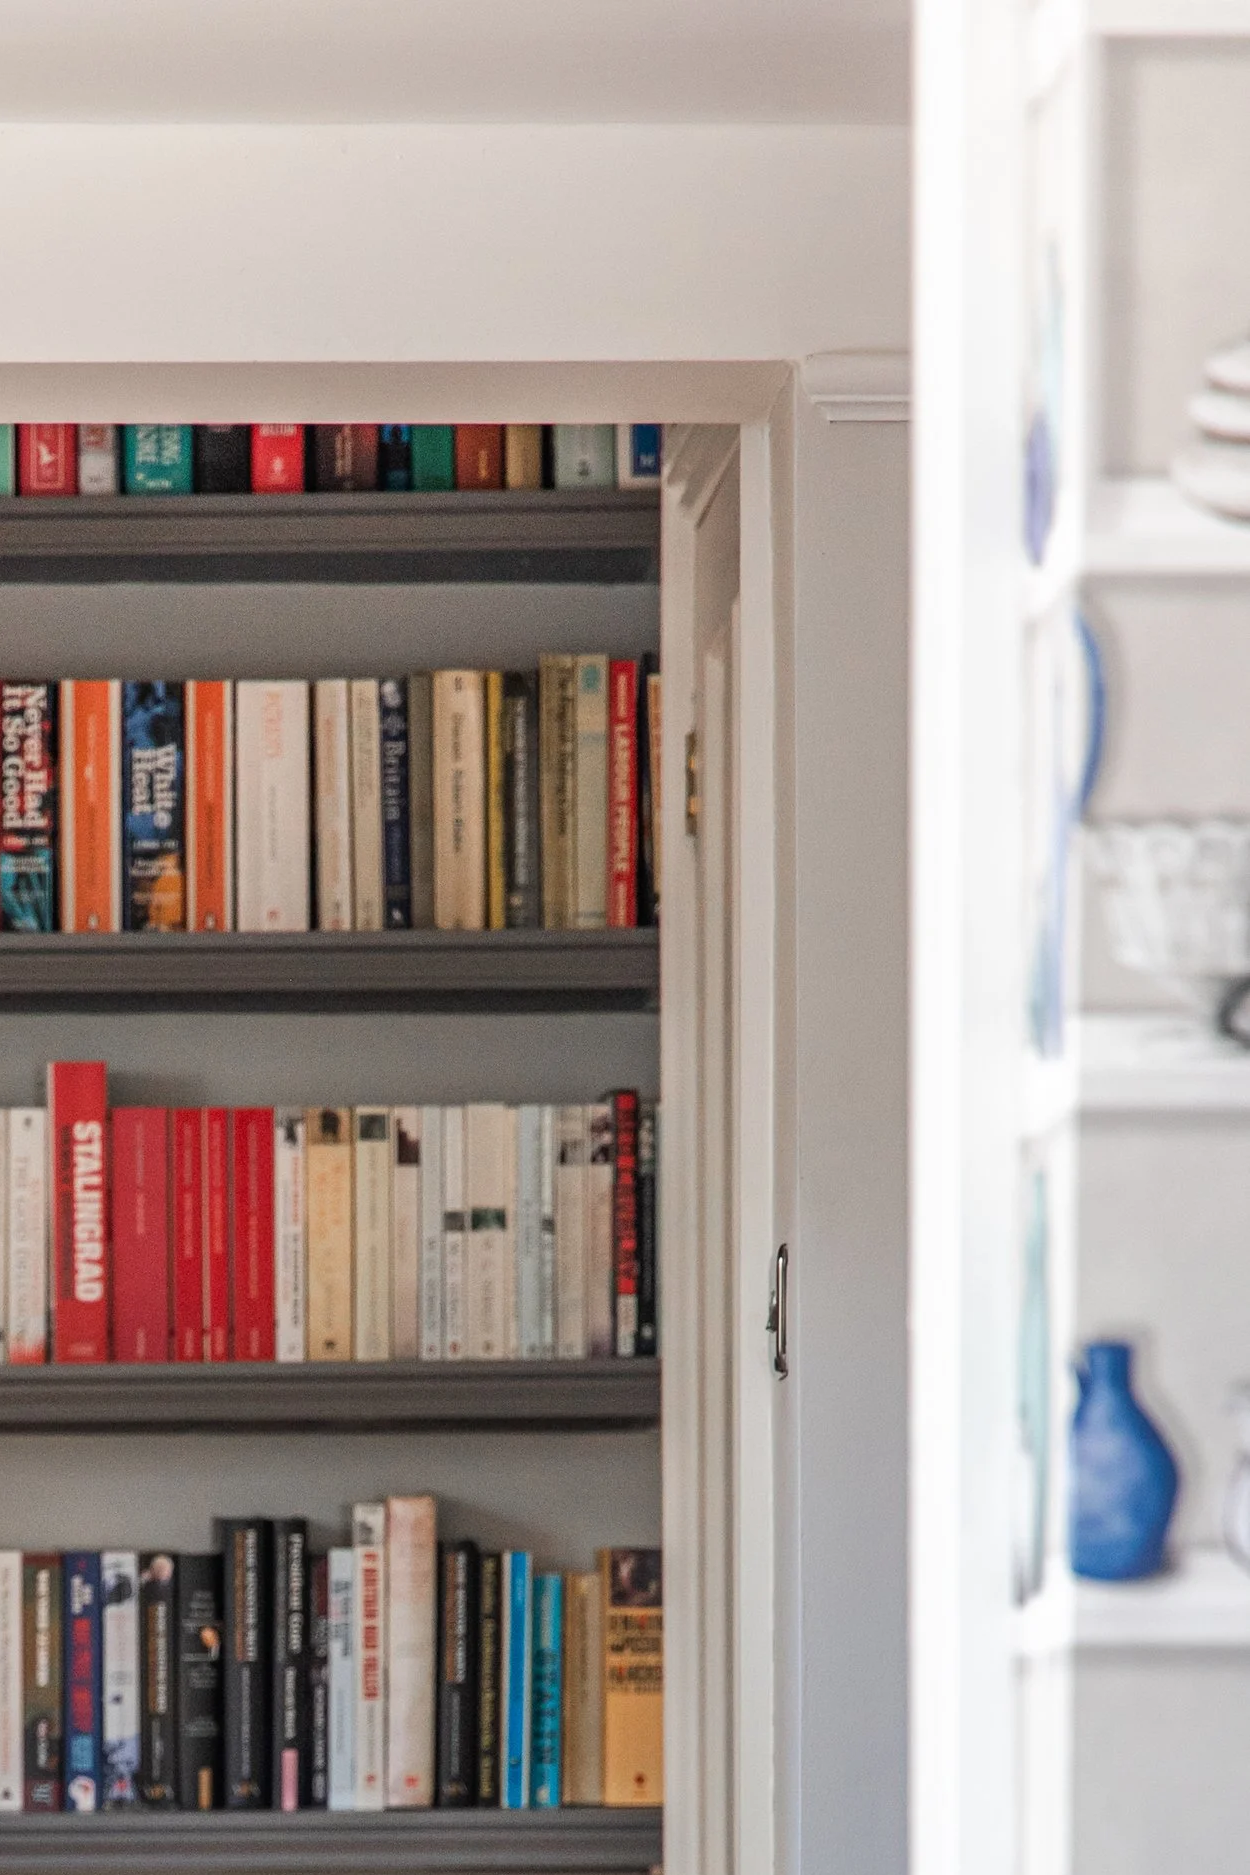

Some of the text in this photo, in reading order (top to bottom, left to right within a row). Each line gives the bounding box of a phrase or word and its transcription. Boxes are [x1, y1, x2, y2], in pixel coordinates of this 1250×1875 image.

[2, 686, 22, 828] It So Good
[24, 686, 46, 828] Never Had
[131, 748, 152, 815] Heat
[154, 744, 176, 828] White
[384, 740, 405, 820] Britain
[614, 724, 630, 801] LABOUR
[614, 807, 630, 874] PEOPLE
[16, 1196, 28, 1242] GOD
[73, 1121, 102, 1302] STALINGRAD
[363, 1567, 378, 1620] BRITAIN
[363, 1625, 378, 1652] HAD
